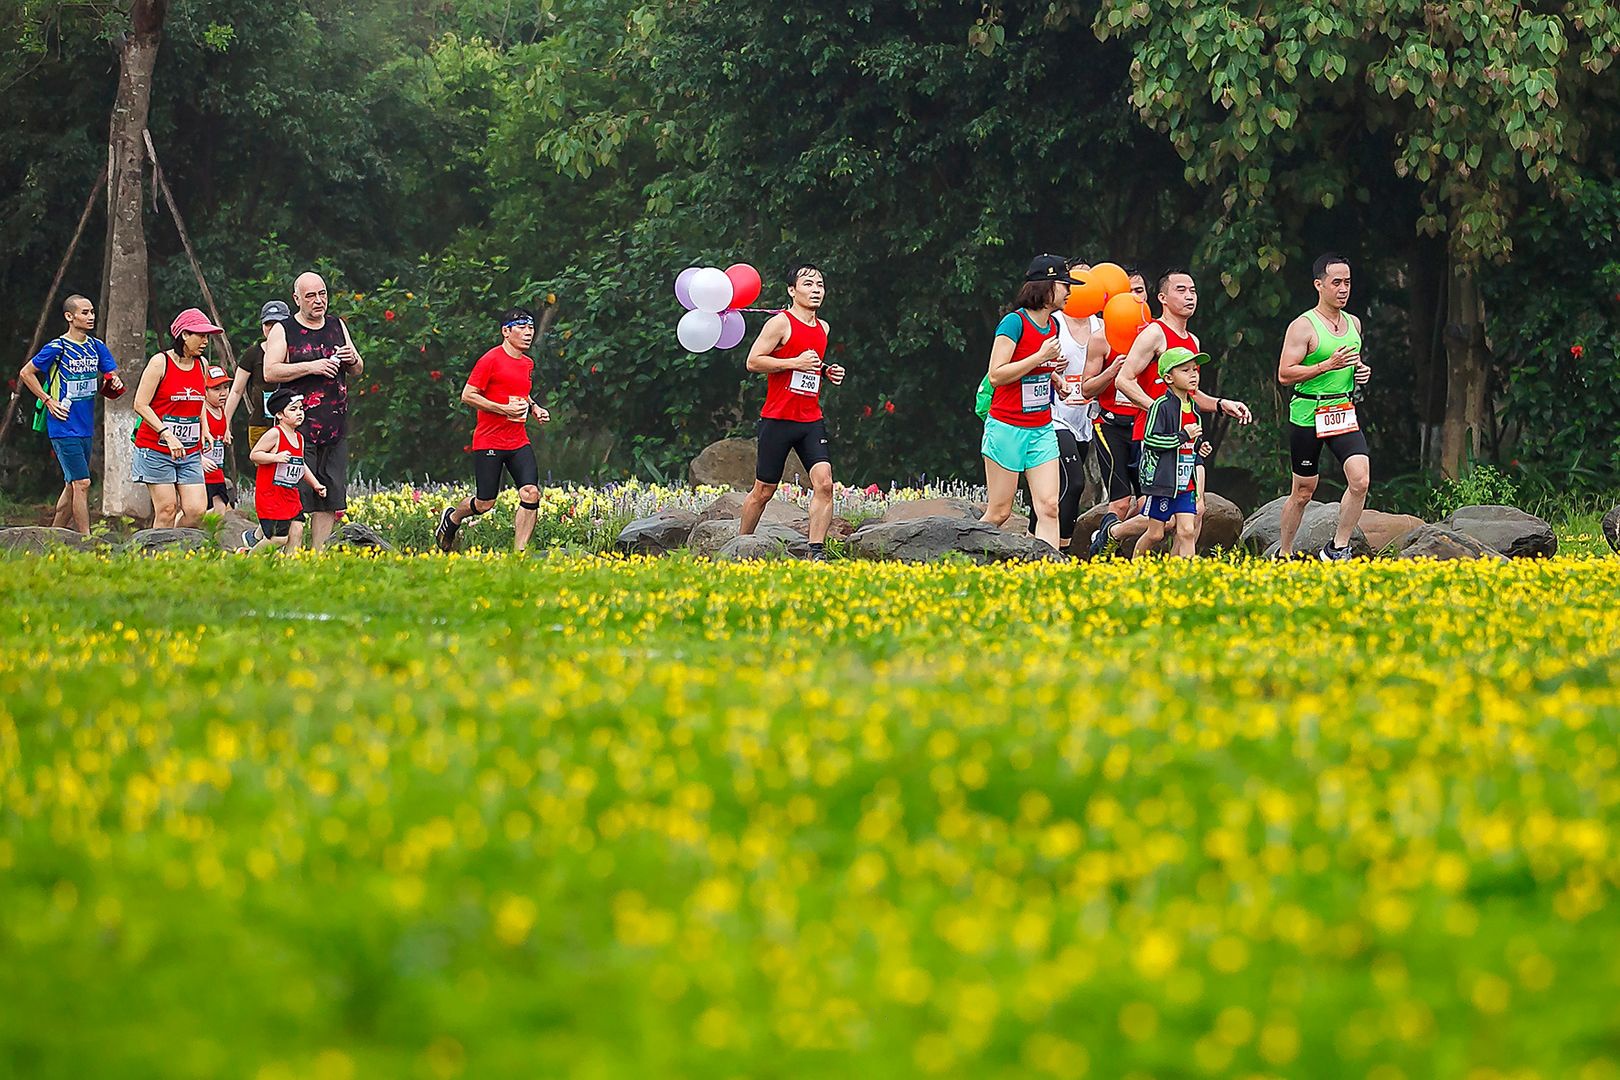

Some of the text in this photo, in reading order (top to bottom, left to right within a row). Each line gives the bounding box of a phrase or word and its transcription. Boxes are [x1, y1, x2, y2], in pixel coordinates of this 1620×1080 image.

[800, 380, 815, 389] 2:00
[1324, 412, 1346, 426] 0307
[172, 424, 192, 438] 1321
